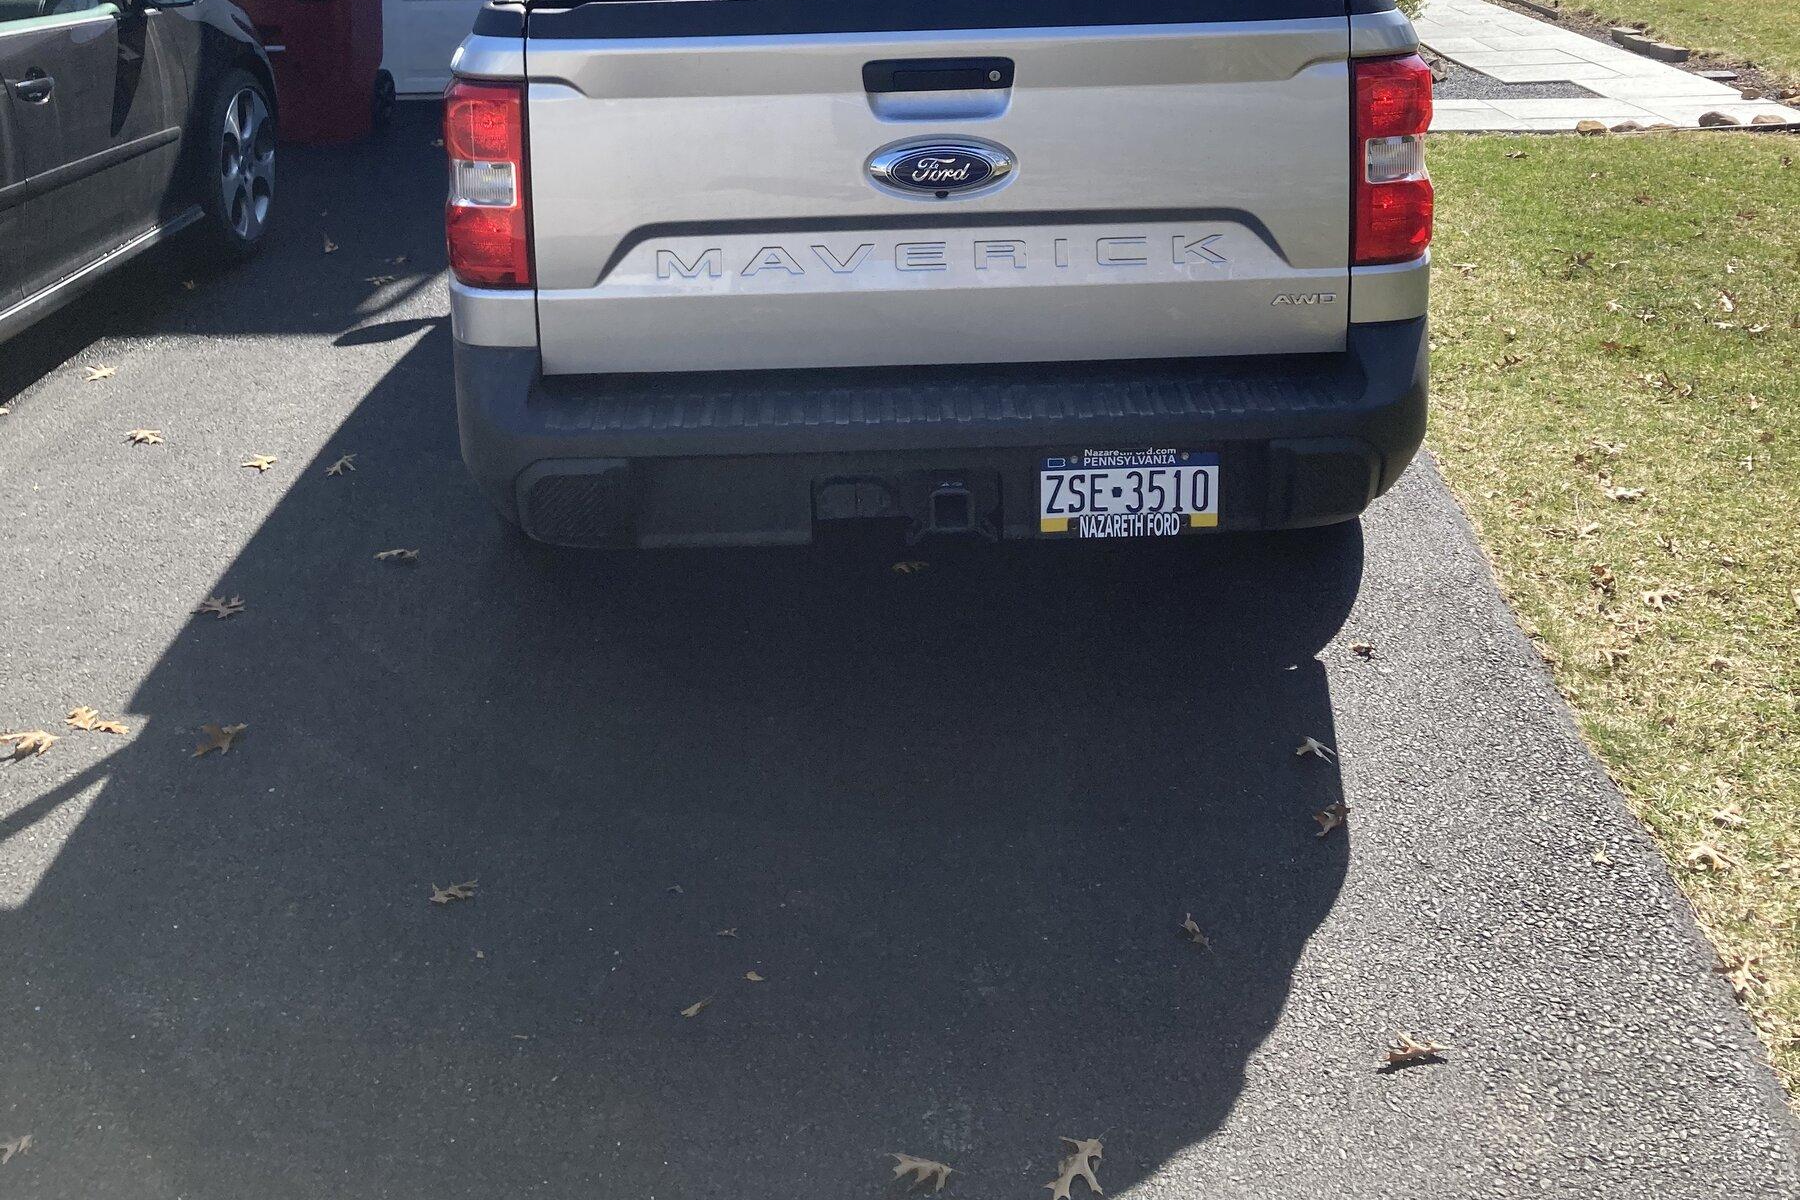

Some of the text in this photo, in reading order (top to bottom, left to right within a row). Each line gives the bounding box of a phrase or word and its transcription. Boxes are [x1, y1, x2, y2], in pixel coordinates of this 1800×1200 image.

[911, 157, 971, 182] Ford
[656, 234, 1228, 279] MAVERICK
[1271, 293, 1337, 306] AWD
[1083, 454, 1176, 467] PENNSYLVANIA
[1084, 446, 1177, 457] Nazared.com
[1079, 512, 1180, 538] NAZARETH FORD
